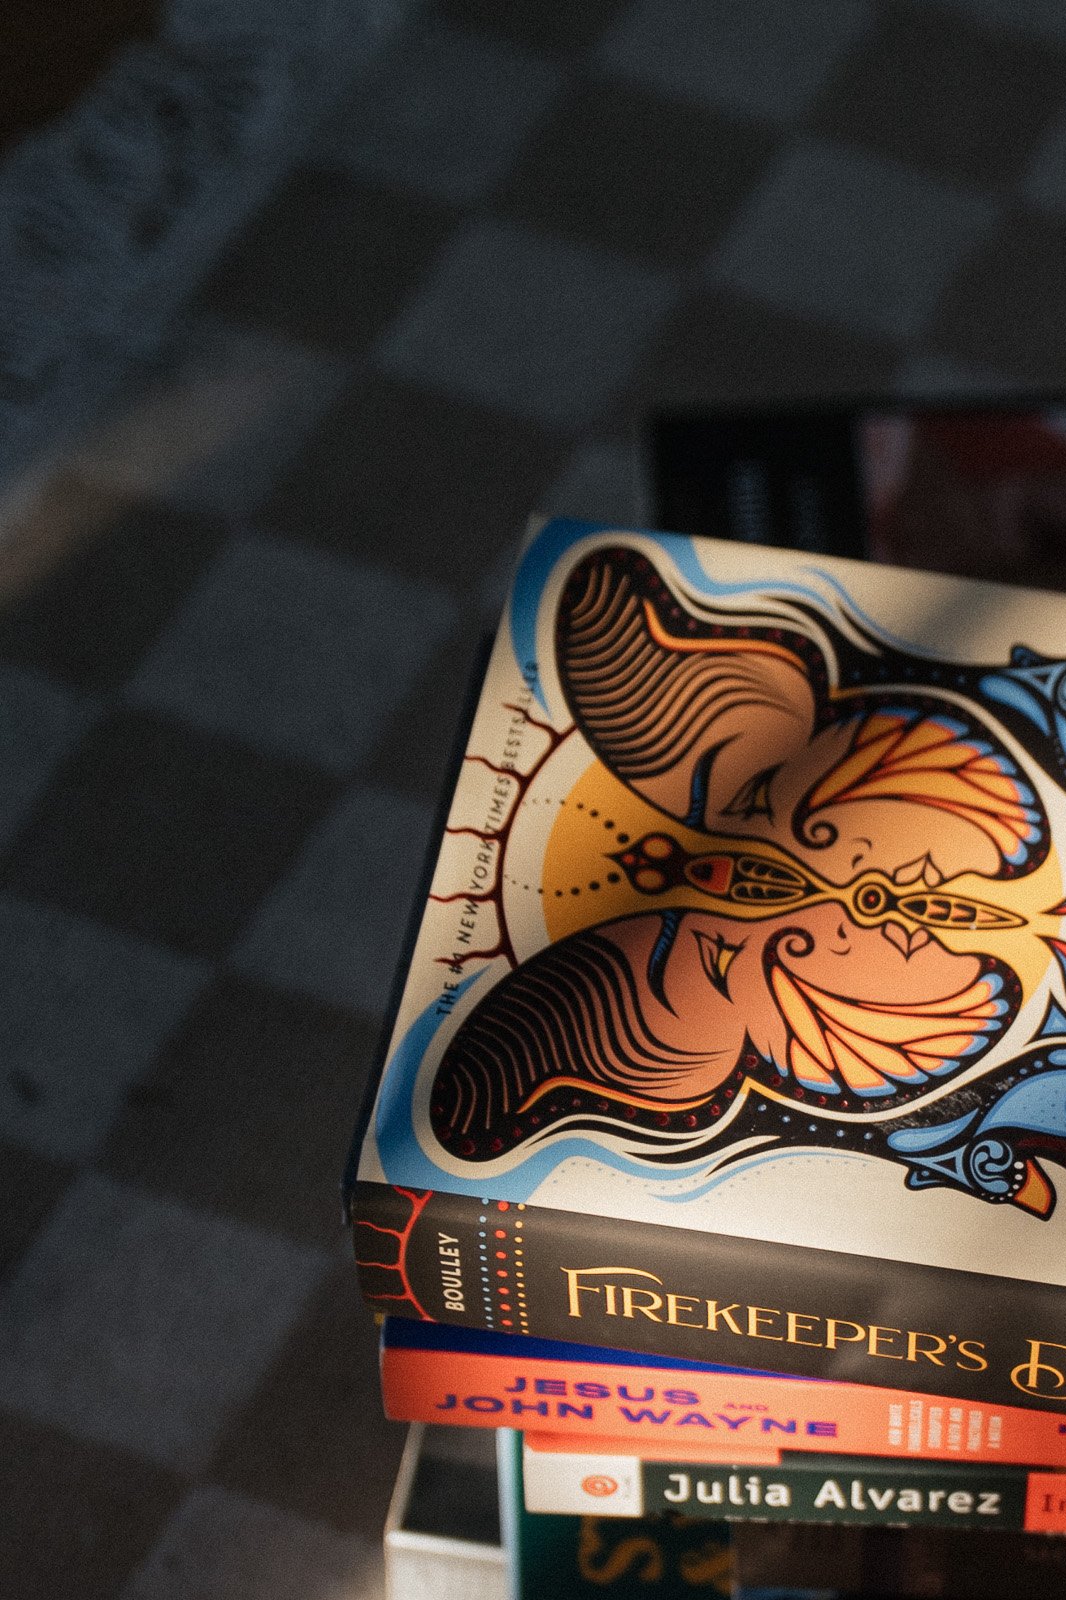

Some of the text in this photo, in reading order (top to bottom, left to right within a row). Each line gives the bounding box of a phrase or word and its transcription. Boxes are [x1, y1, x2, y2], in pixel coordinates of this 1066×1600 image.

[436, 983, 459, 1016] THE
[456, 899, 480, 946] NEW
[470, 836, 498, 897] YORK
[485, 776, 511, 833] TIMES
[438, 1232, 467, 1313] BOULLEY
[560, 1265, 988, 1373] FIREKEEPER'S
[434, 1393, 839, 1438] JOHN WAYNE
[504, 1376, 770, 1413] JESUS AND
[664, 1470, 792, 1508] Julia
[813, 1478, 1002, 1516] Alvarez
